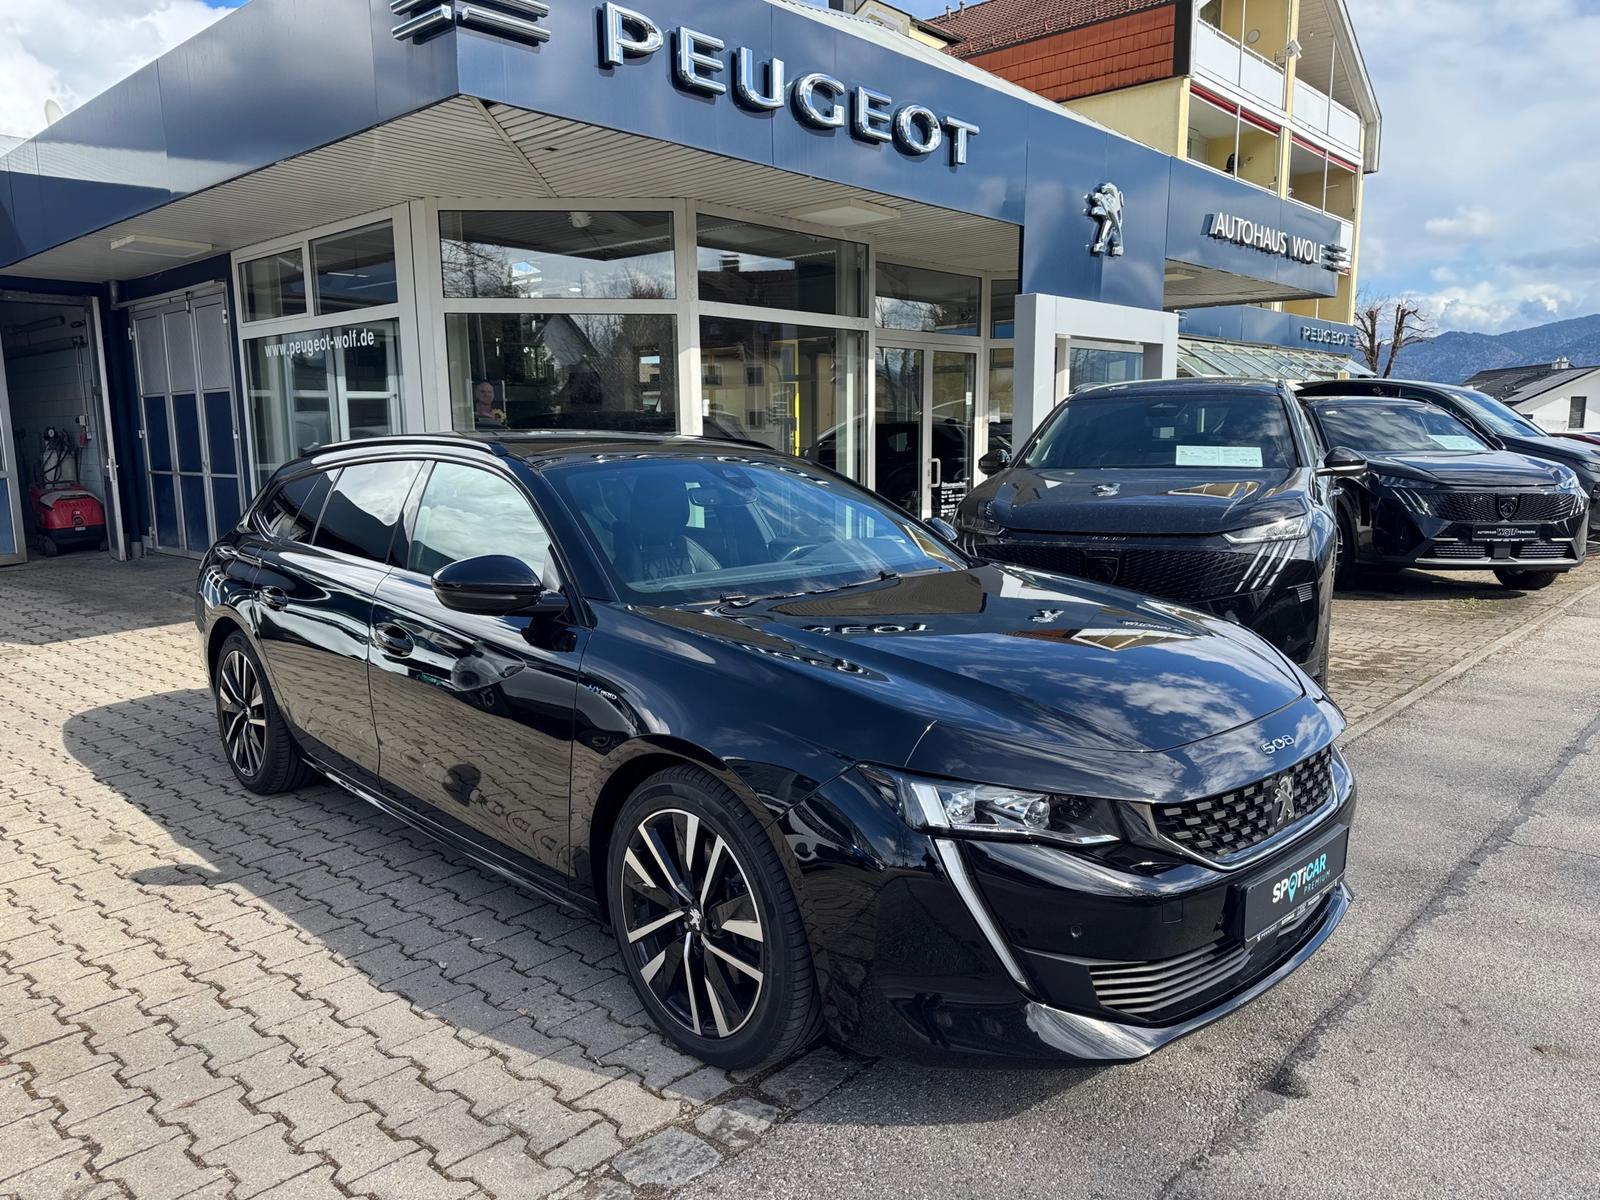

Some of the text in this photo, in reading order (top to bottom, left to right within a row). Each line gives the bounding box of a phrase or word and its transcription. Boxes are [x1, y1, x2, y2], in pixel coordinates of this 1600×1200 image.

[599, 1, 980, 166] PEUGEOT
[1214, 212, 1325, 264] AUTOHAUS WOLF
[264, 328, 375, 358] www.peugeot-wolf.de
[1303, 326, 1349, 346] PEUGEOT
[1260, 734, 1295, 755] 508
[1303, 869, 1331, 895] PREMIUM
